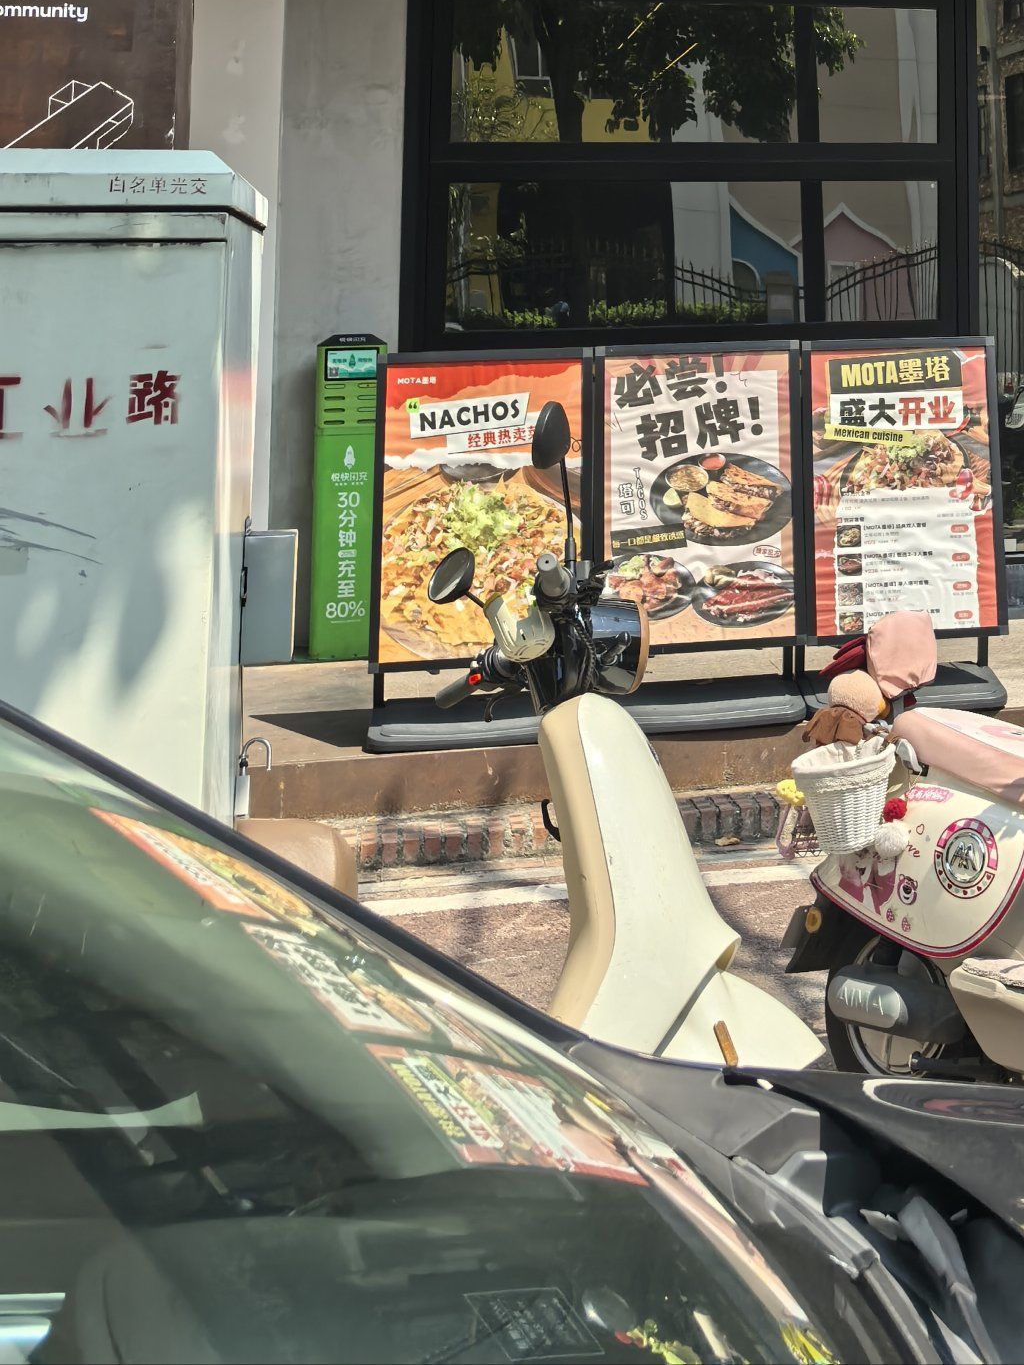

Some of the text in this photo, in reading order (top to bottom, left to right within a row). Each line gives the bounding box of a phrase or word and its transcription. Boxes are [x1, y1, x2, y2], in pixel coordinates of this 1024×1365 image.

[841, 355, 951, 388] MOTA墨塔
[419, 399, 520, 432] NACHOS
[839, 395, 957, 427] 盛大开业
[834, 427, 903, 443] Mexican cuisine
[618, 482, 635, 515] 塔可
[633, 467, 648, 520] TACOS
